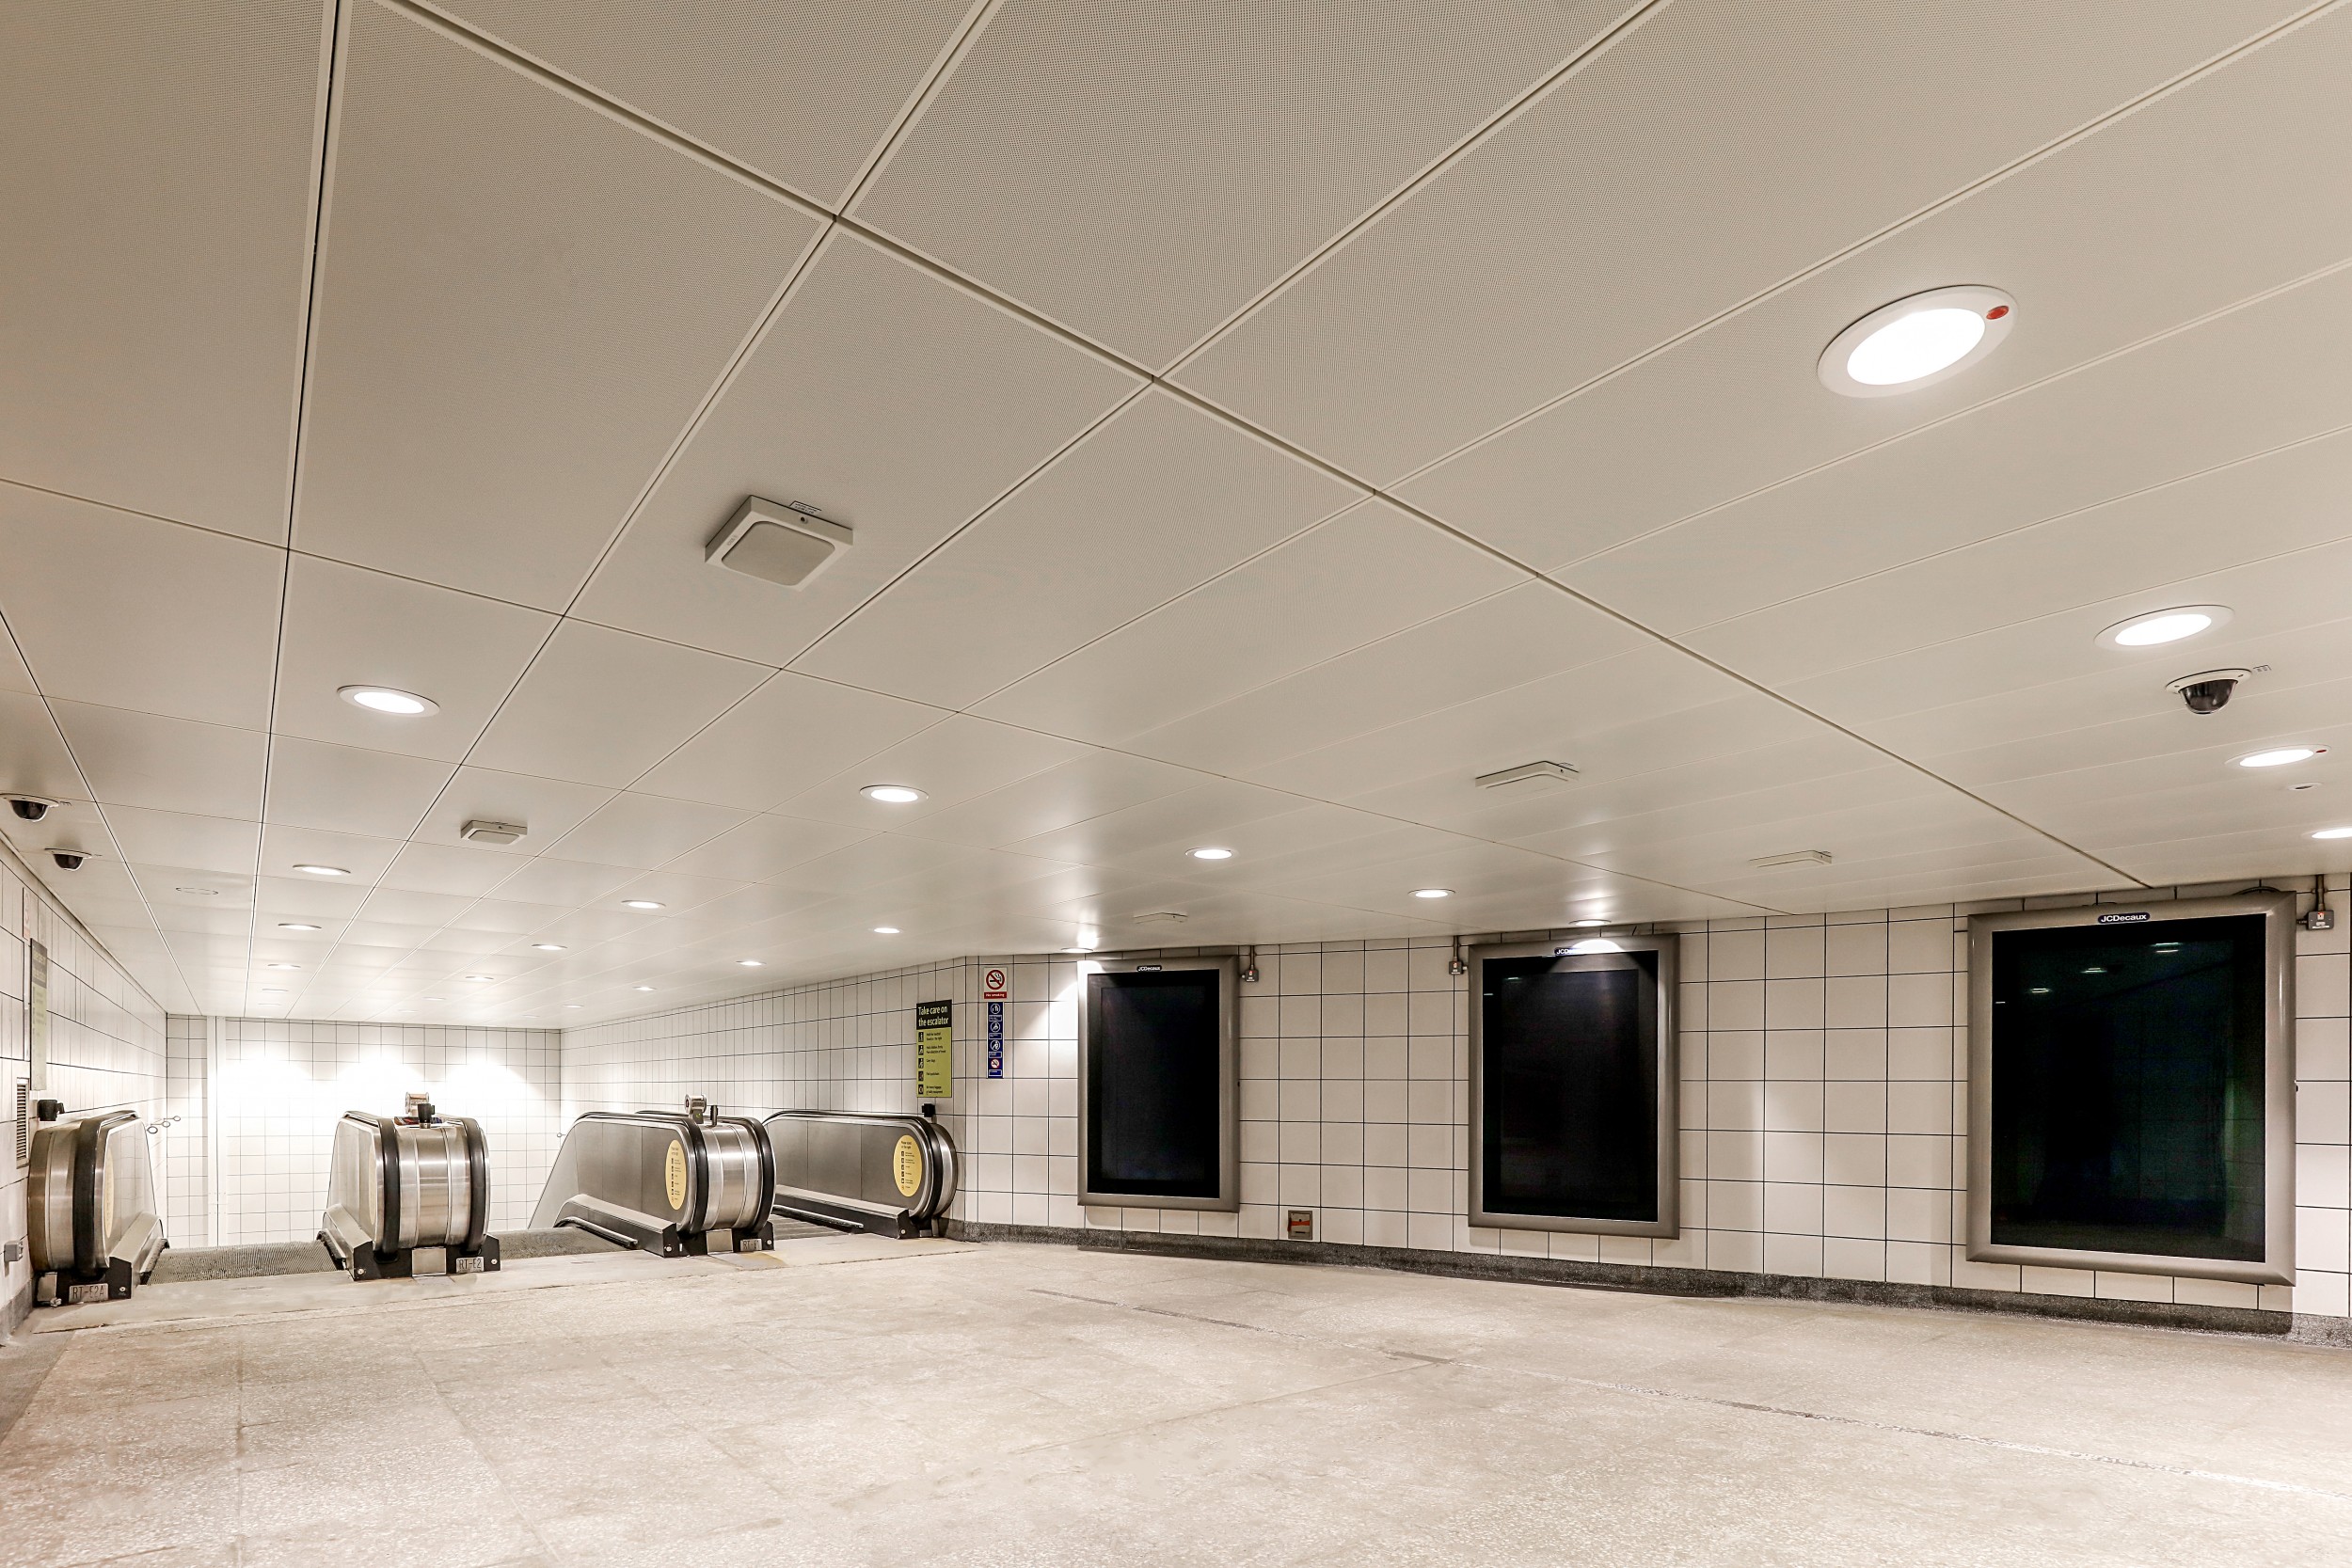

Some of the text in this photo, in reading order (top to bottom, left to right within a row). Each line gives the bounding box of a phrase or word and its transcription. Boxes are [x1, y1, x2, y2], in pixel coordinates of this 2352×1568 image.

[2101, 914, 2147, 923] JCDecaux
[918, 1006, 930, 1016] Take
[918, 1016, 949, 1026] the escalator
